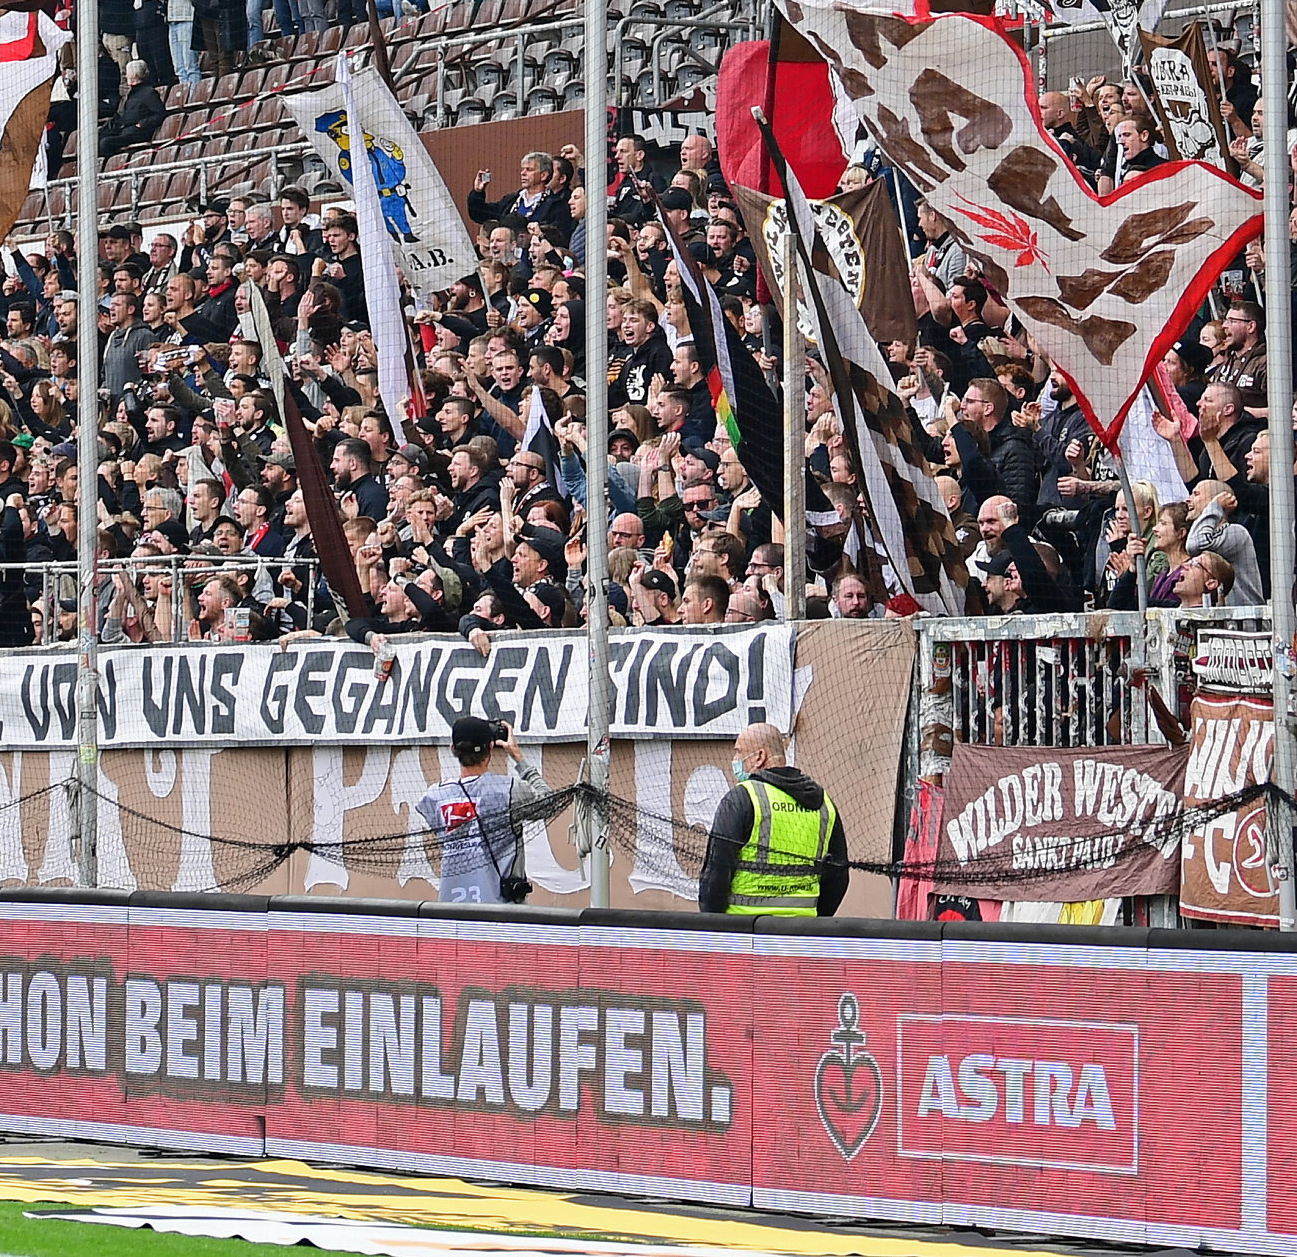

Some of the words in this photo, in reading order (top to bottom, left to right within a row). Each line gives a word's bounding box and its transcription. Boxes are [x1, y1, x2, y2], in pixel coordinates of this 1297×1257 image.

[142, 652, 244, 736] UNS
[260, 643, 573, 735] GEGANGEN
[946, 761, 1063, 866] WILDER
[125, 977, 285, 1085] BEIM
[304, 987, 733, 1123] EINLAUFEN.
[916, 1053, 1117, 1131] ASTRA
